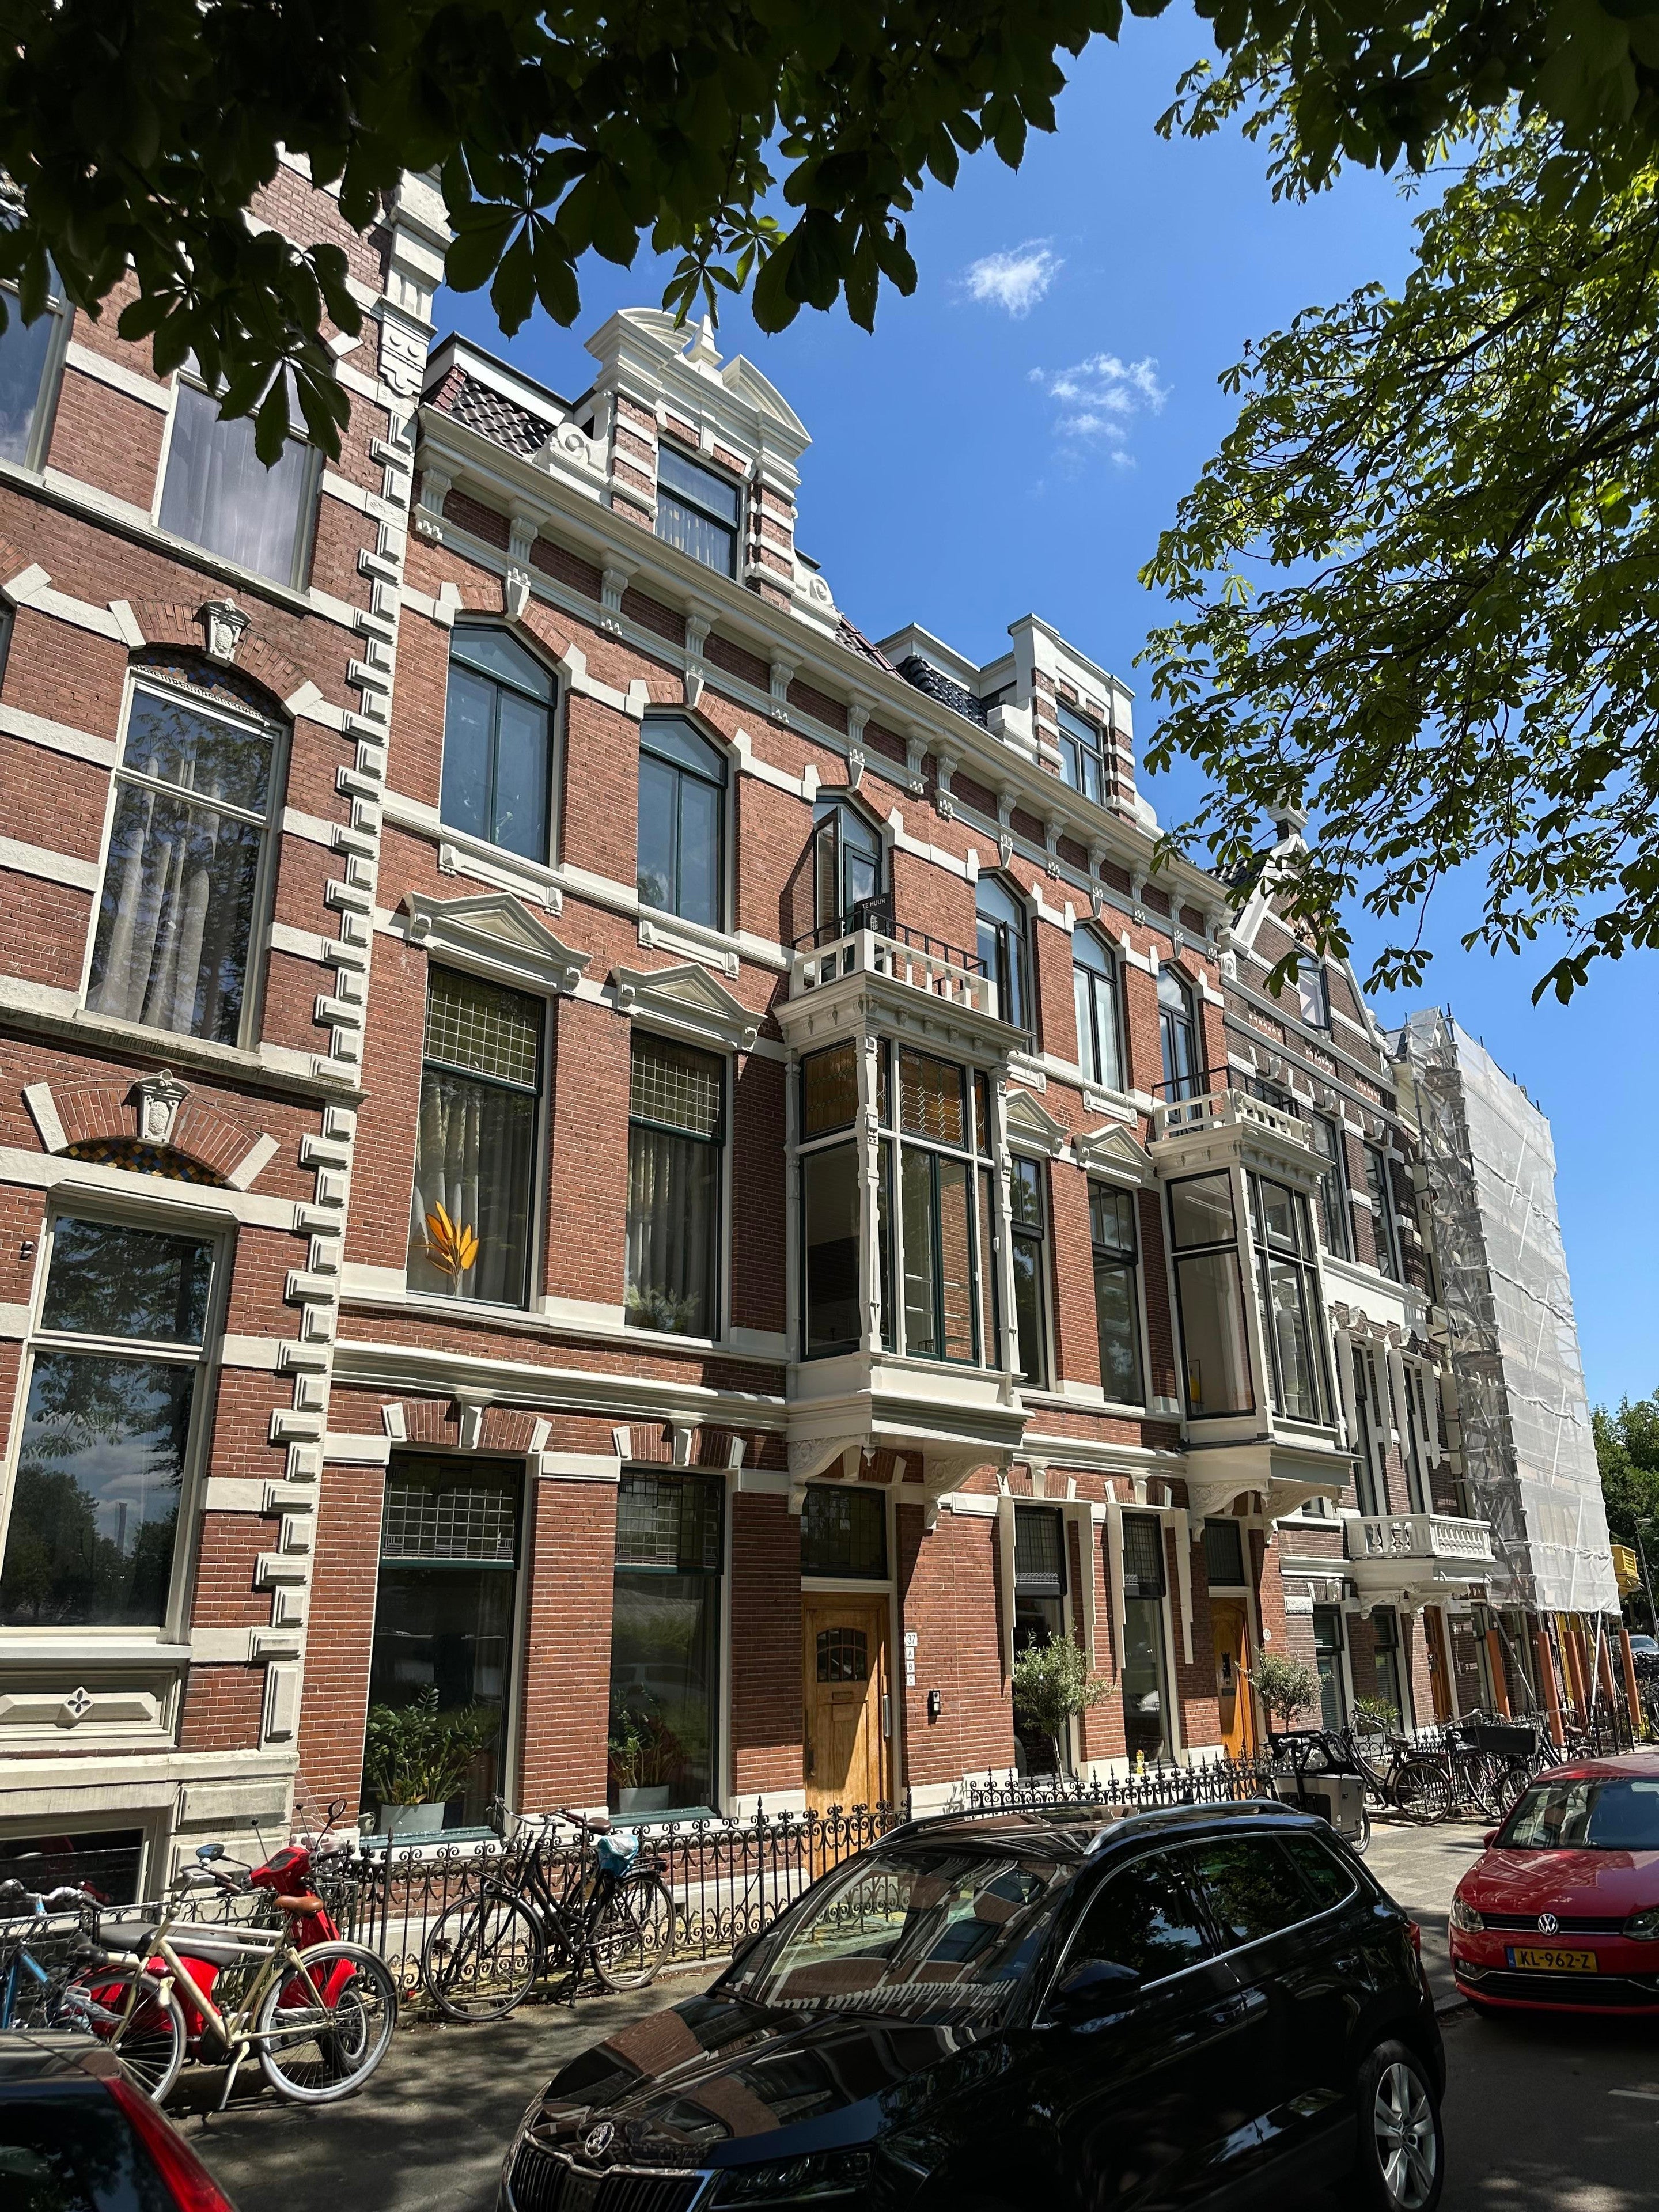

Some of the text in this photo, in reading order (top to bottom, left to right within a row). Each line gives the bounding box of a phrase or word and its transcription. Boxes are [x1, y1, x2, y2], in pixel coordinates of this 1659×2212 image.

[869, 898, 886, 908] HUUR
[907, 1634, 916, 1645] 37
[1520, 1950, 1591, 1969] KL-962-Z
